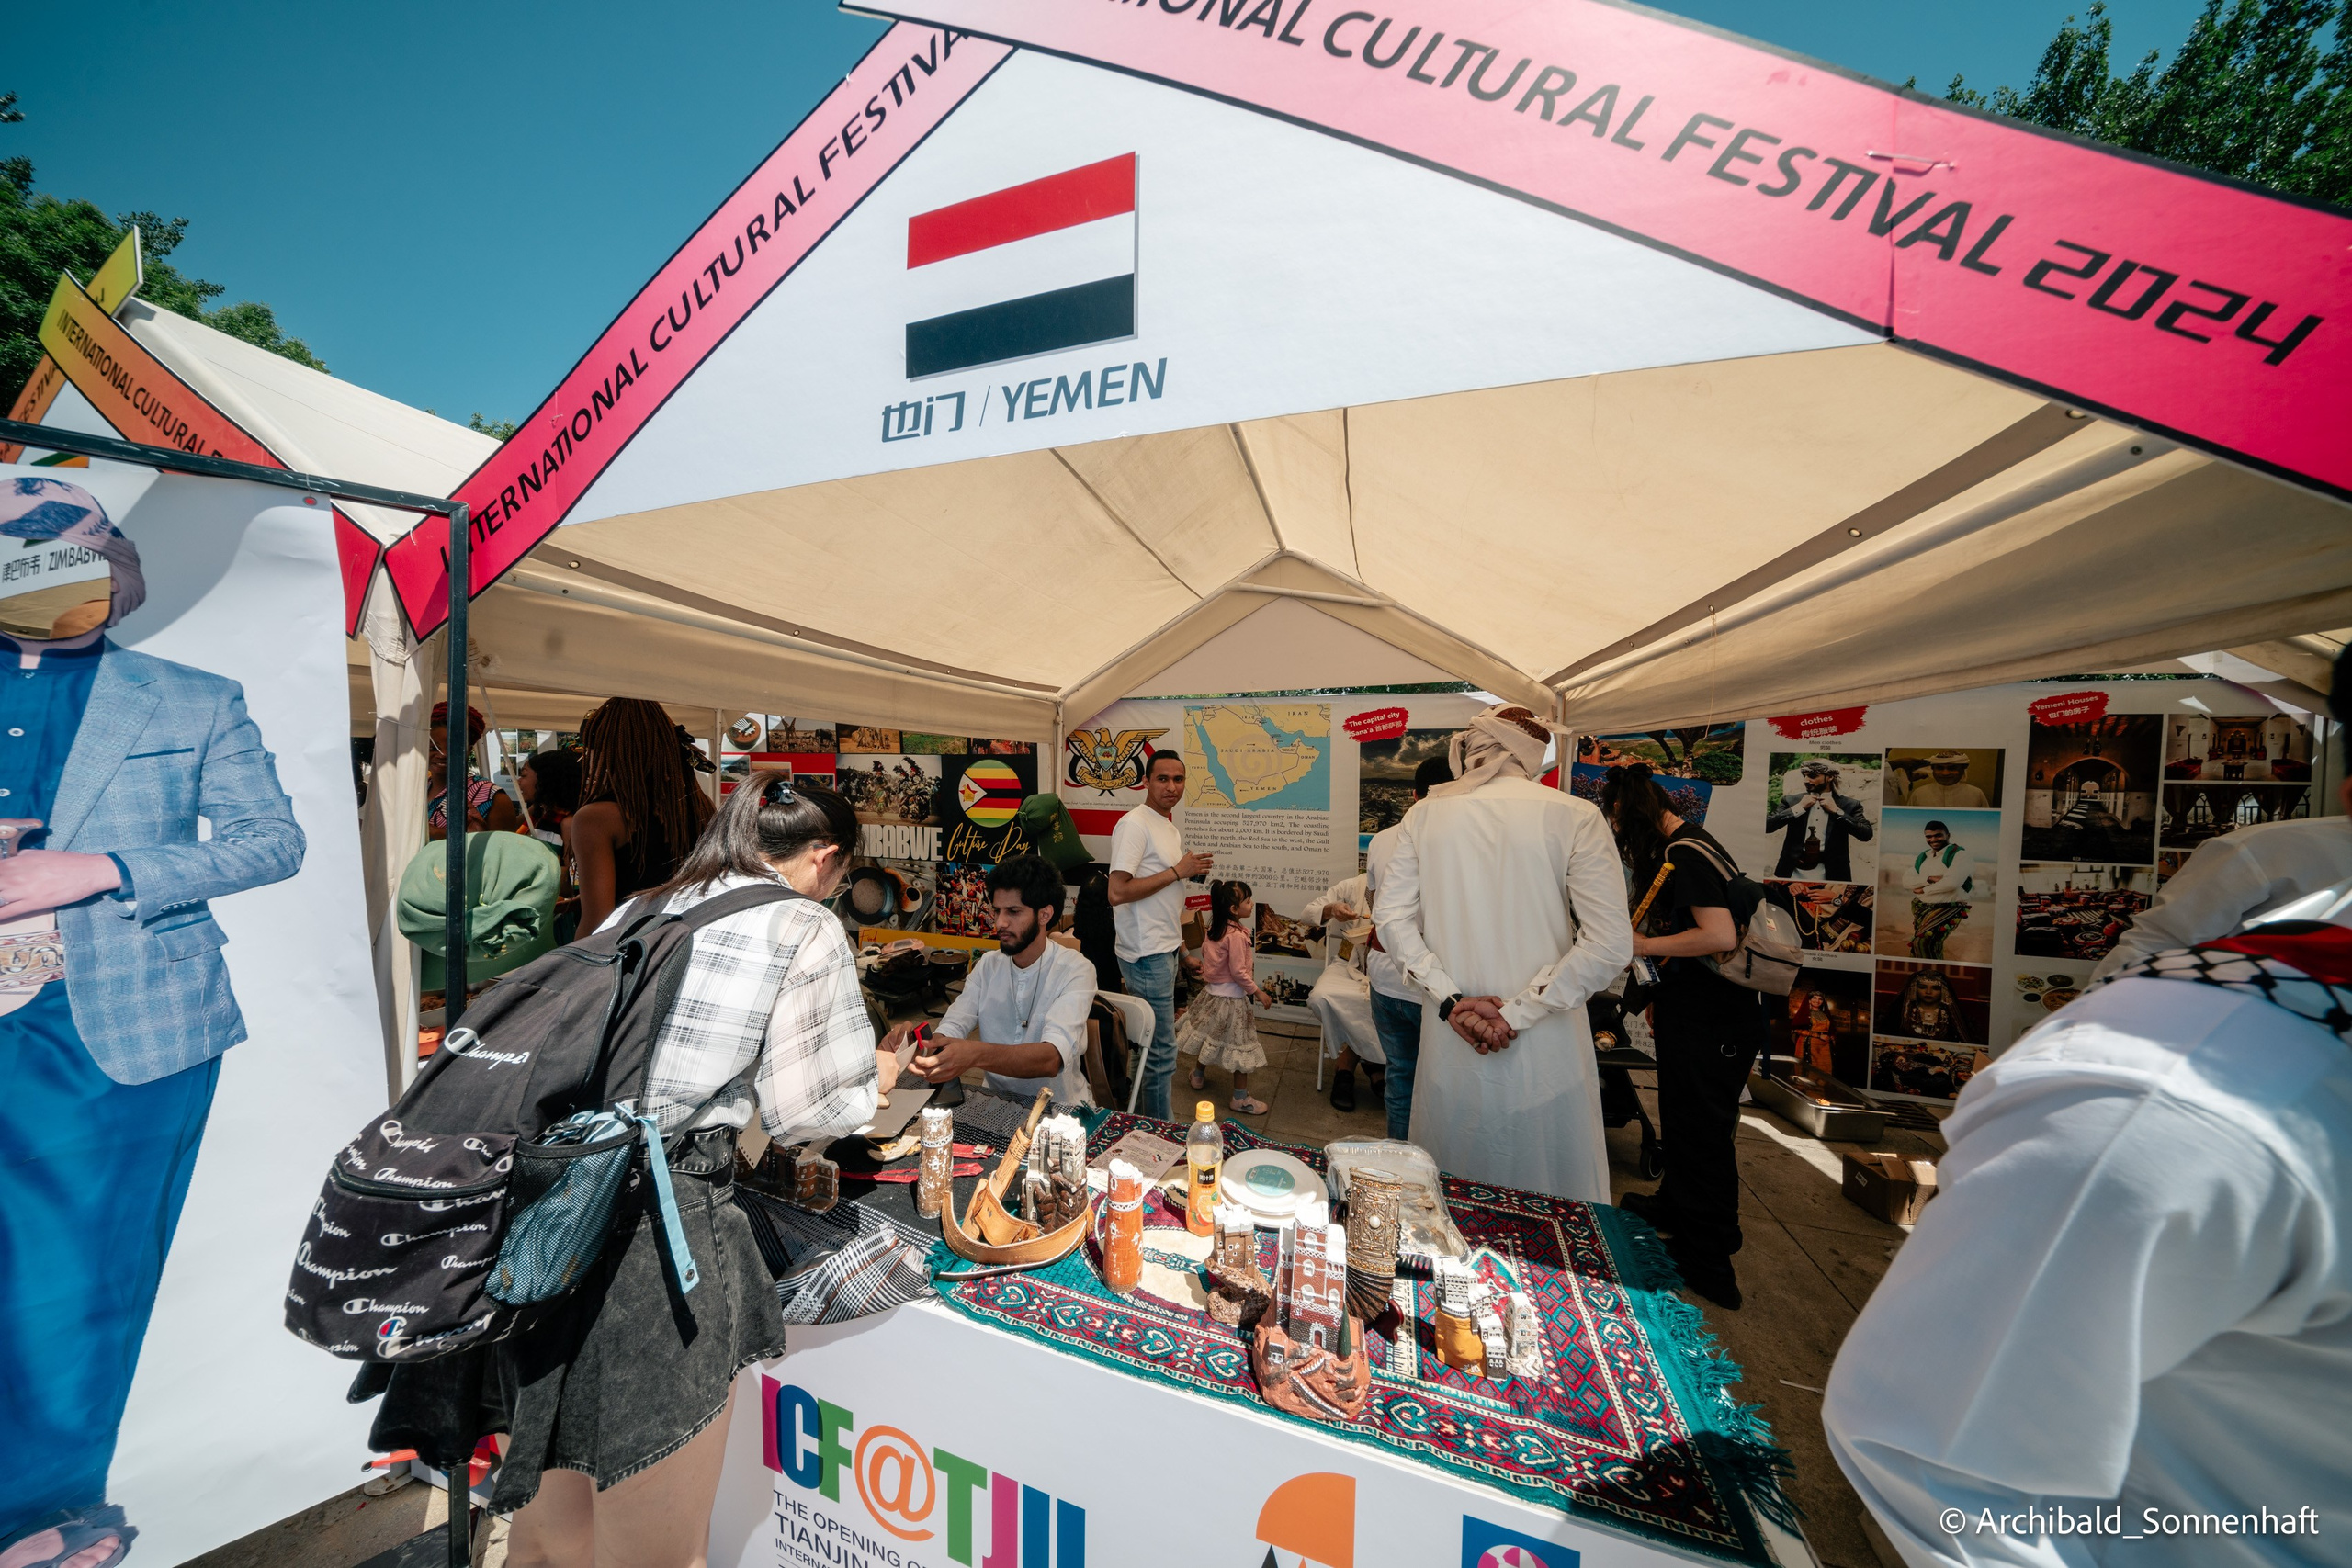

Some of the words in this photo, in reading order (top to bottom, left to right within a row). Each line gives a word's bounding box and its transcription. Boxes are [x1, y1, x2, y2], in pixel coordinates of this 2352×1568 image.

[1322, 11, 1655, 151] CULTURAL
[1661, 112, 2014, 276] FESTIVAL
[2023, 239, 2324, 367] 2024
[439, 348, 649, 574] ITERNATIONAL
[650, 175, 816, 352] CULTURAL
[818, 28, 970, 182] FESTIVA
[57, 309, 135, 401] INTERNATIONAL
[1001, 356, 1168, 423] YEMEN
[1363, 714, 1385, 725] capital
[1800, 716, 1834, 727] clothes
[2035, 700, 2065, 711] Yemeni
[2067, 695, 2099, 705] Houses
[946, 822, 989, 862] Culture
[989, 821, 1031, 863] Day
[374, 1168, 457, 1189] Champion
[381, 1223, 488, 1247] Champion
[297, 1241, 398, 1289] Champion
[343, 1297, 429, 1317] Champion
[773, 1489, 808, 1521] THE
[813, 1512, 901, 1568] OPENING
